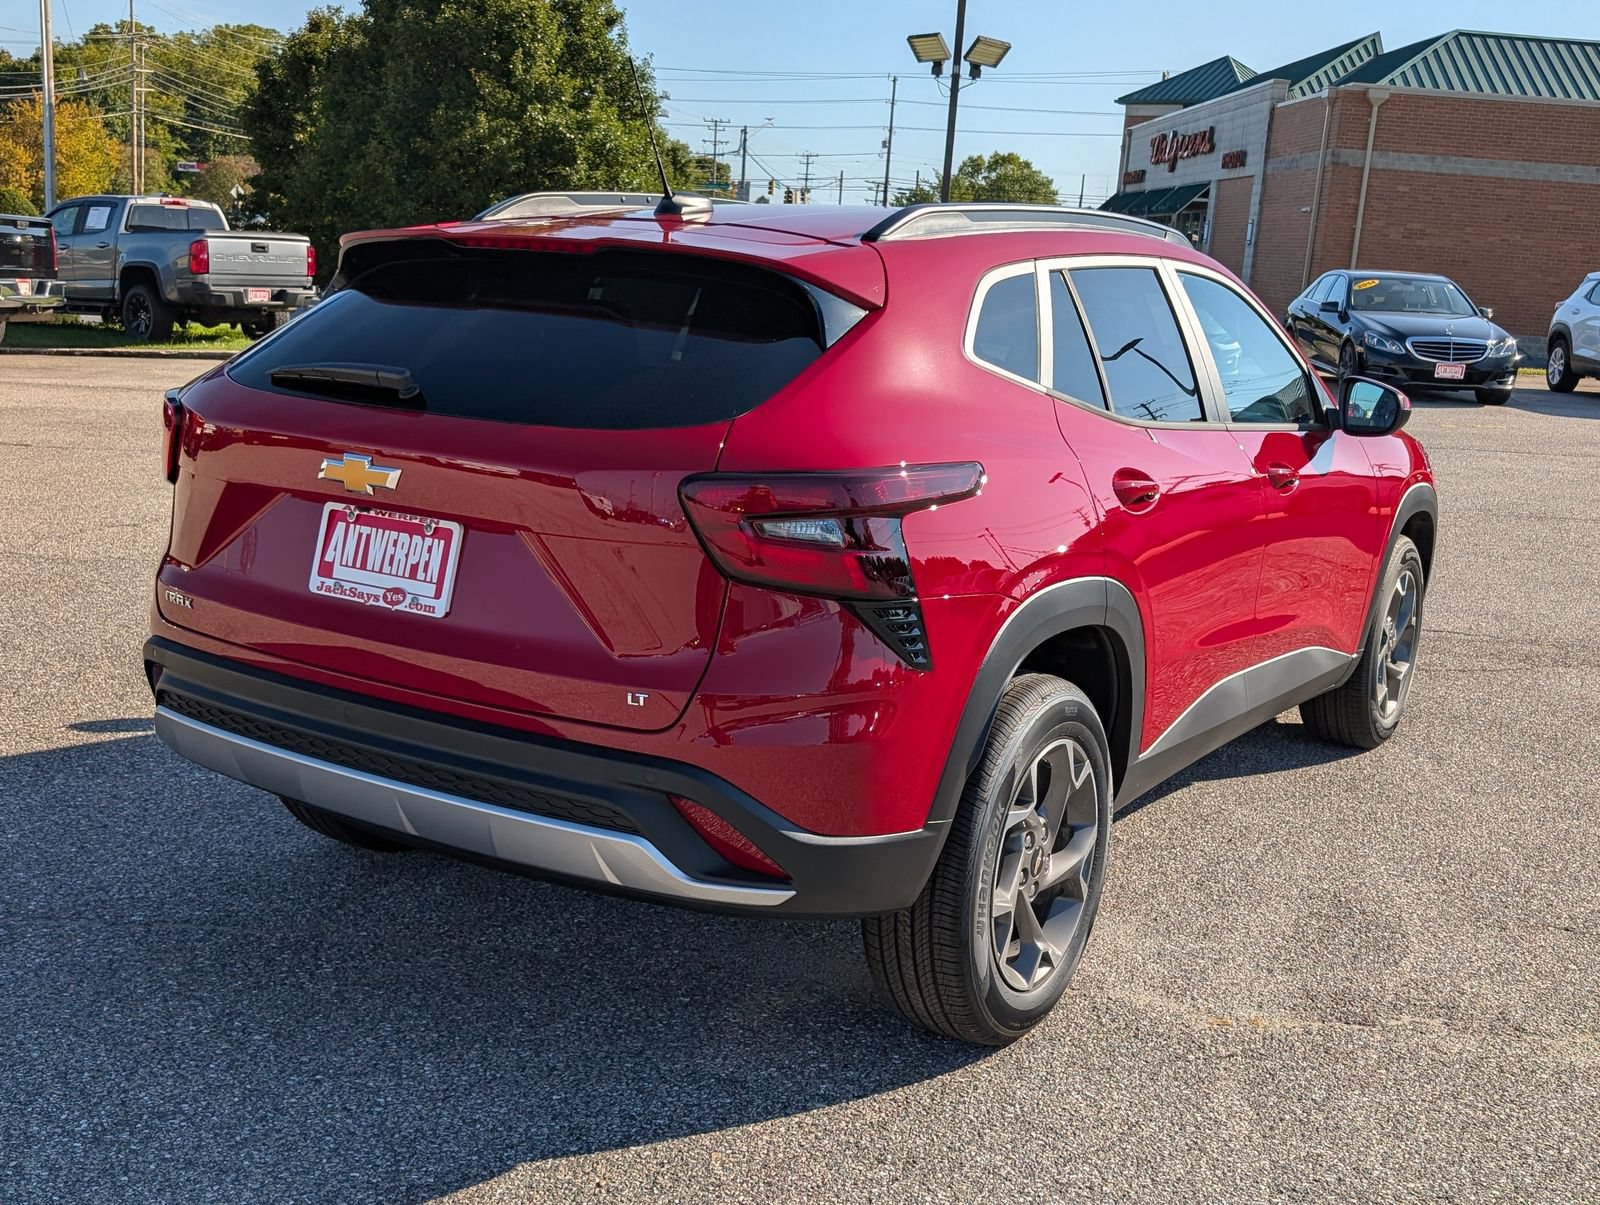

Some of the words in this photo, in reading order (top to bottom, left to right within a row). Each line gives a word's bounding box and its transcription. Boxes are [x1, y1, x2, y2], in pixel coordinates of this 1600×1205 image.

[1150, 126, 1216, 172] Walgreens
[213, 253, 304, 264] CHEVROLET
[324, 521, 445, 585] ANTWERPEN
[385, 591, 404, 602] Yes
[627, 692, 648, 706] LT
